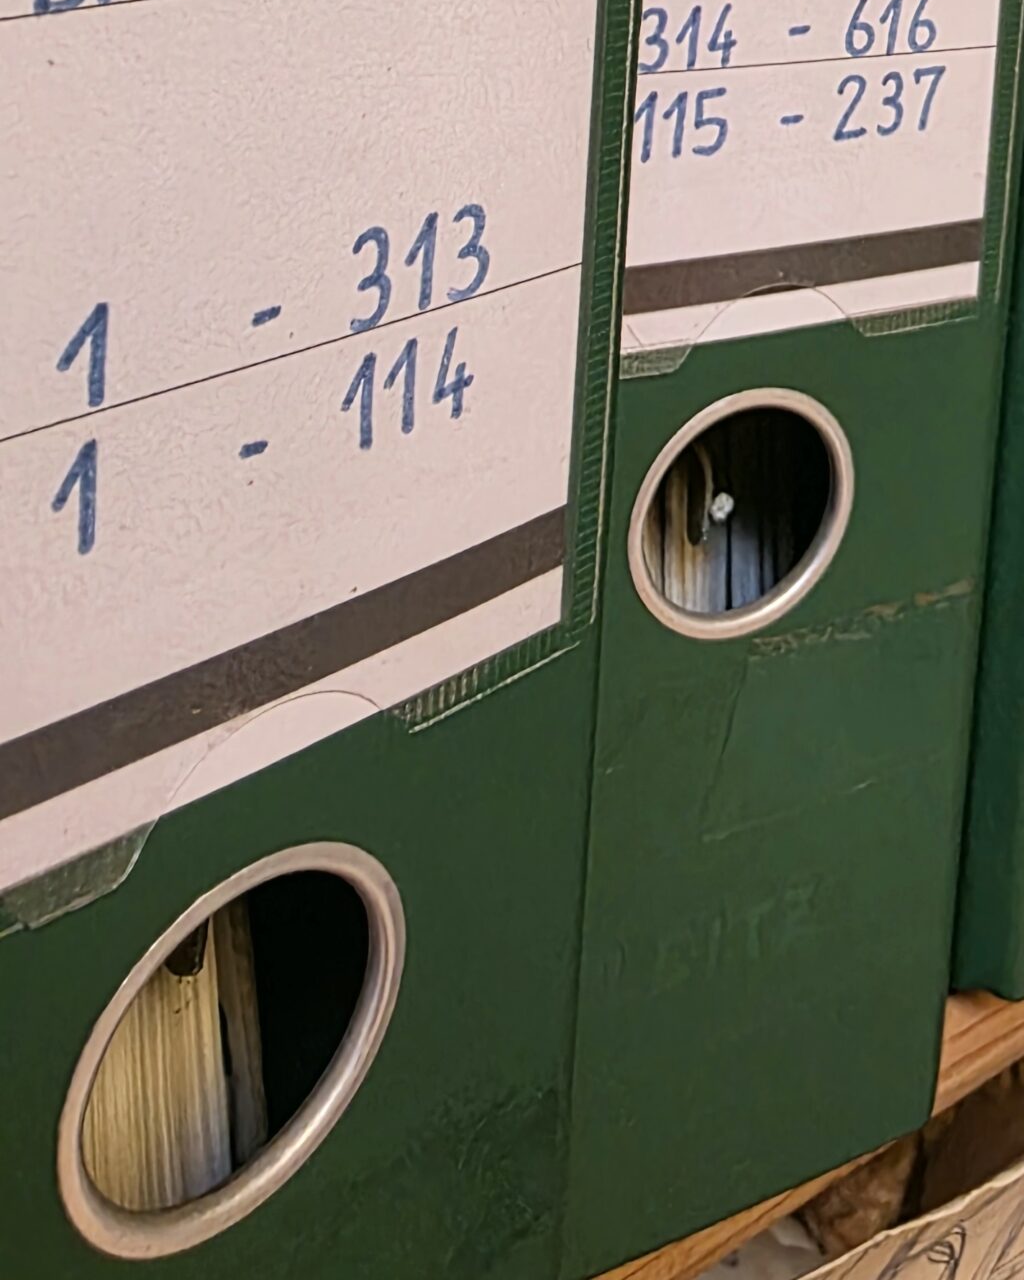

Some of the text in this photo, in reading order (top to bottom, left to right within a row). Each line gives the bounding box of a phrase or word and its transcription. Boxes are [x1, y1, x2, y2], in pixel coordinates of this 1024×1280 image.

[633, 86, 730, 164] 115
[832, 64, 946, 143] 237
[637, 2, 738, 74] 314
[55, 301, 109, 407] 1
[349, 203, 492, 333] 313
[51, 437, 98, 556] 1
[341, 326, 475, 451] 114
